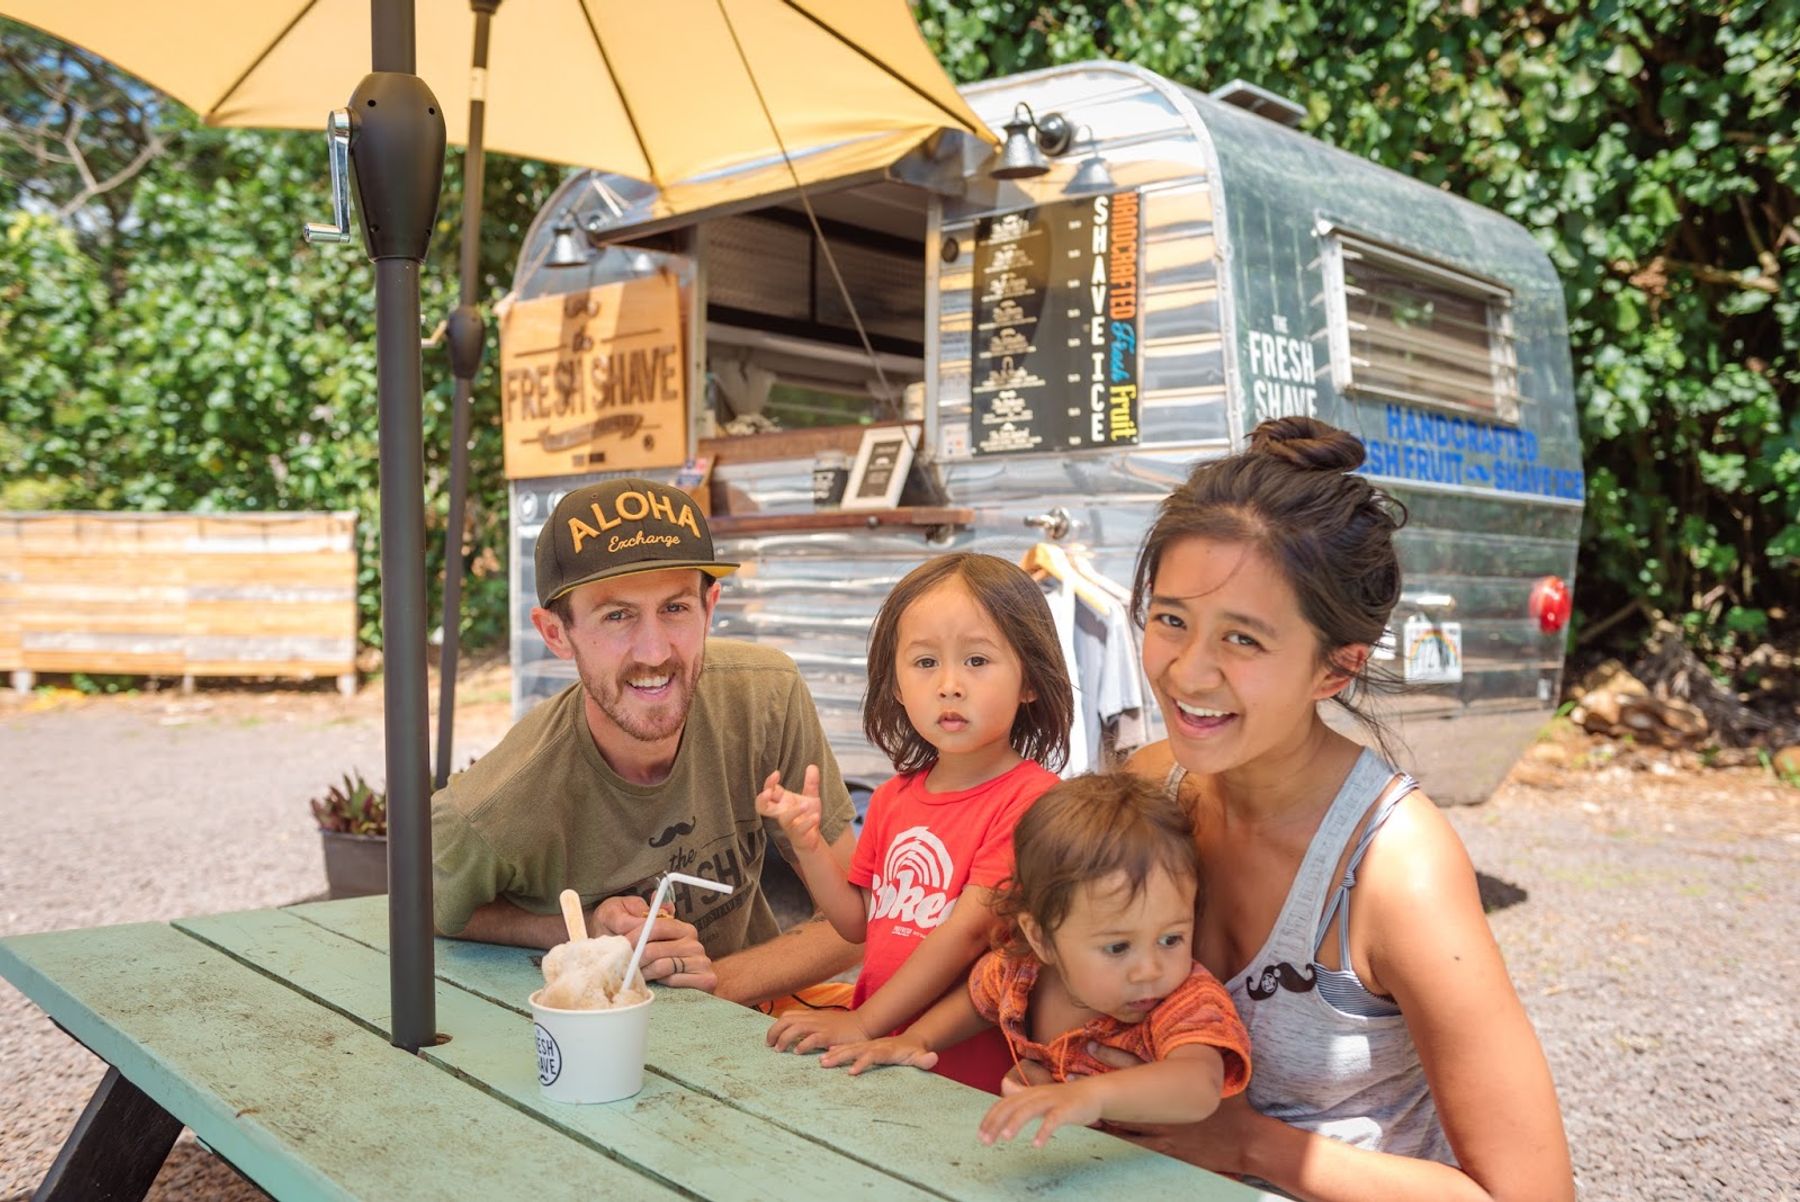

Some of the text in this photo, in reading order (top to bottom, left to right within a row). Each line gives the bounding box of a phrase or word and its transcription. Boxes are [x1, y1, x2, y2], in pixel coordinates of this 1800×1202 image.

[1091, 195, 1109, 442] SHAVE ICE
[1109, 192, 1138, 441] HANDCRAFTED Fresh Fruit
[506, 345, 678, 422] FRESH SHAVE
[1249, 330, 1316, 385] FRESH
[1386, 404, 1538, 463] HANDCRAFTED
[1404, 447, 1463, 485] FRUIT
[568, 491, 701, 553] ALOHA
[608, 531, 680, 553] Exchange
[668, 846, 698, 872] the
